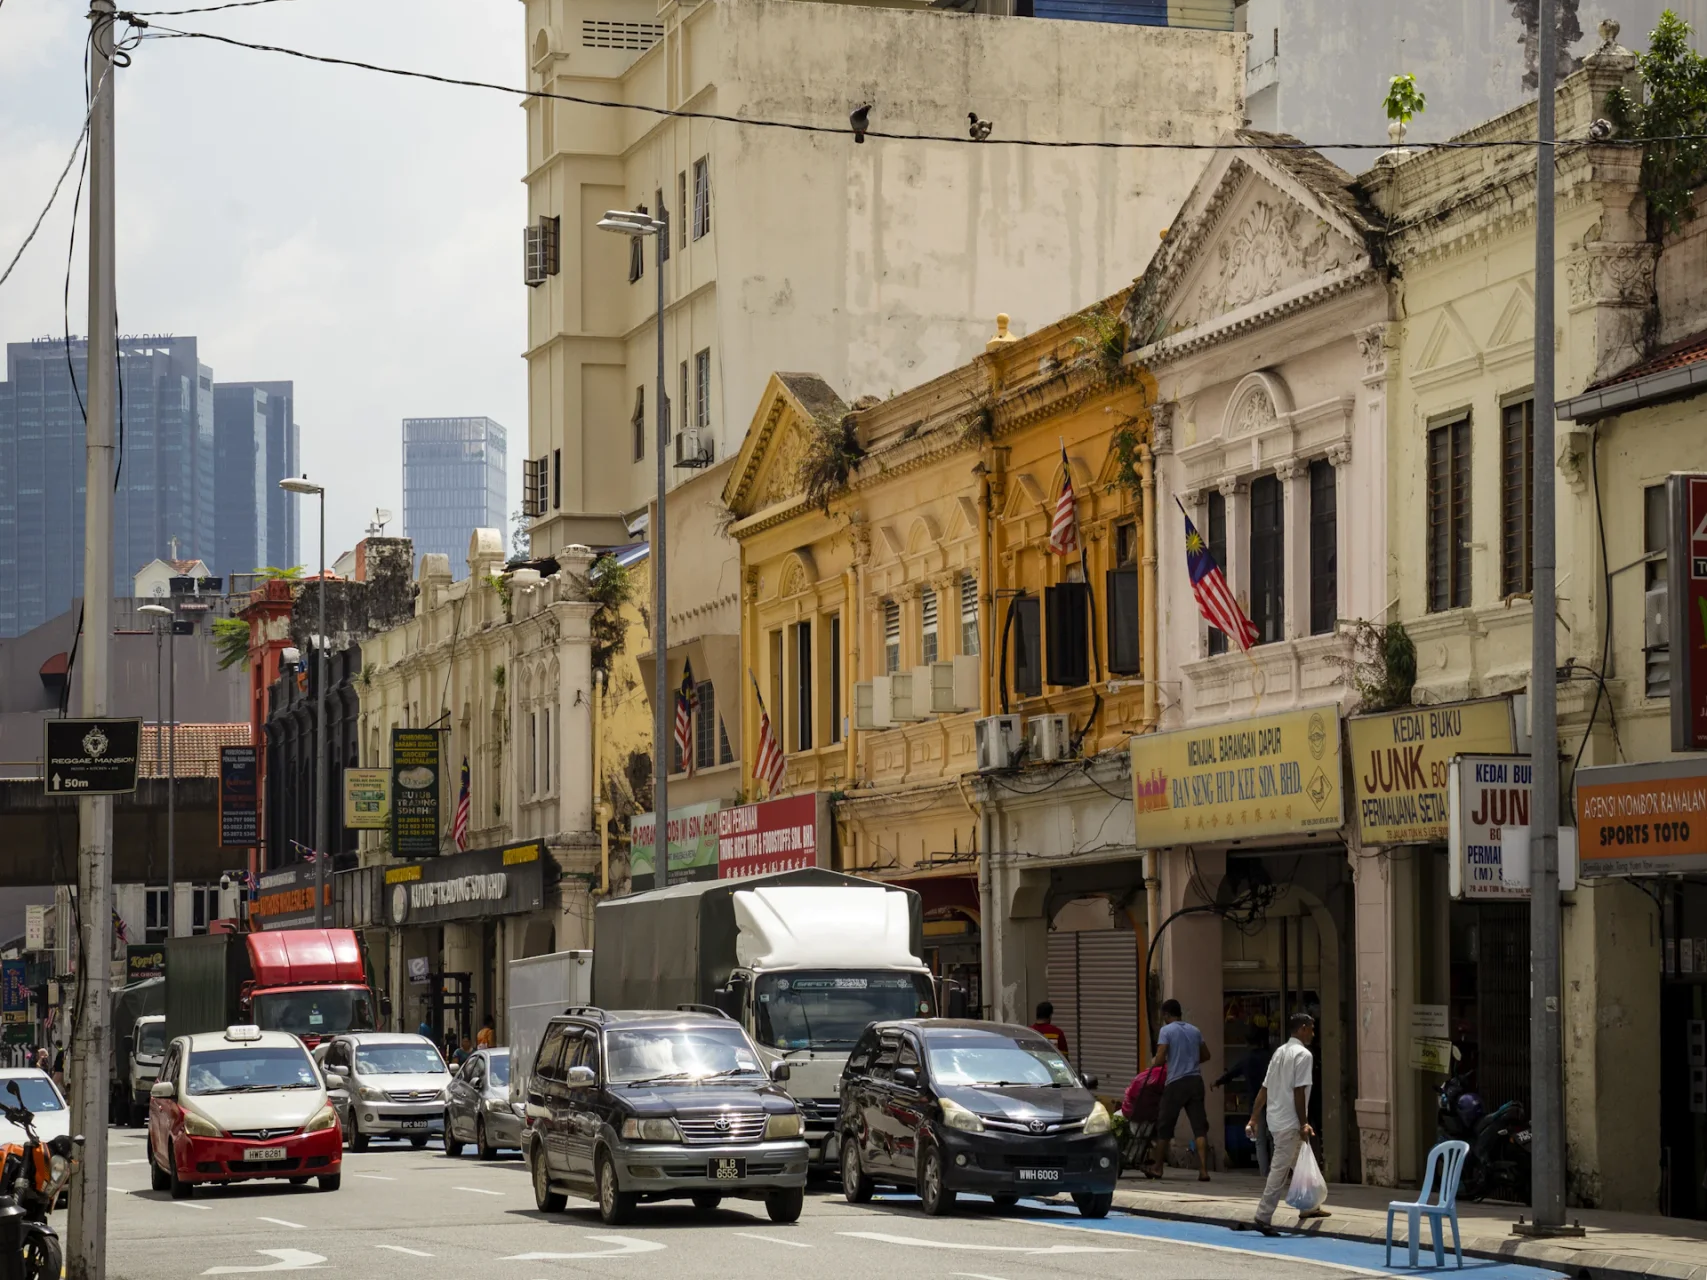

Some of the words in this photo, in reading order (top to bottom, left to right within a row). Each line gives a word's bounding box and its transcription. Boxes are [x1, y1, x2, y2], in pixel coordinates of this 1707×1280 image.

[83, 334, 139, 348] BKOK
[142, 333, 175, 347] BANK
[1392, 715, 1425, 743] KEDAI
[1430, 710, 1462, 739] BUKU
[1187, 737, 1217, 767] MENJUAL
[1219, 731, 1257, 762] BARANGAN
[1259, 727, 1281, 757] DAPUR
[51, 757, 92, 765] REGGAE
[94, 756, 135, 764] MANSION
[1364, 744, 1428, 794] JUNK
[1431, 762, 1447, 788] BO
[1475, 764, 1507, 783] KEDAI
[1513, 765, 1532, 784] BU
[64, 778, 89, 788] 50m
[1172, 777, 1190, 809] BAN
[1192, 772, 1214, 807] SENG
[1216, 770, 1235, 804] HUP
[1237, 768, 1256, 801] KEE
[1258, 764, 1278, 799] SDN.
[1280, 761, 1303, 795] BHD.
[397, 799, 437, 807] TRADING
[1418, 792, 1447, 823] SETIA
[1472, 788, 1532, 825] JUN
[1584, 795, 1616, 819] AGENSI
[1617, 792, 1659, 817] NOMBOR
[1661, 788, 1707, 813] RAMALAN
[1489, 828, 1501, 841] BO
[1600, 823, 1649, 846] SPORTS
[1654, 821, 1690, 842] TOTO
[1468, 845, 1502, 865] PERMAI
[1474, 867, 1493, 881] (M)
[411, 881, 434, 908] KUTUB
[437, 875, 472, 905] TRADING
[1421, 1048, 1437, 1058] 50%
[249, 1150, 264, 1159] HWE
[264, 1150, 281, 1158] 8281
[719, 1158, 736, 1169] WLB
[716, 1168, 738, 1179] 6552
[1019, 1169, 1037, 1180] WWH
[1037, 1169, 1059, 1180] 6003
